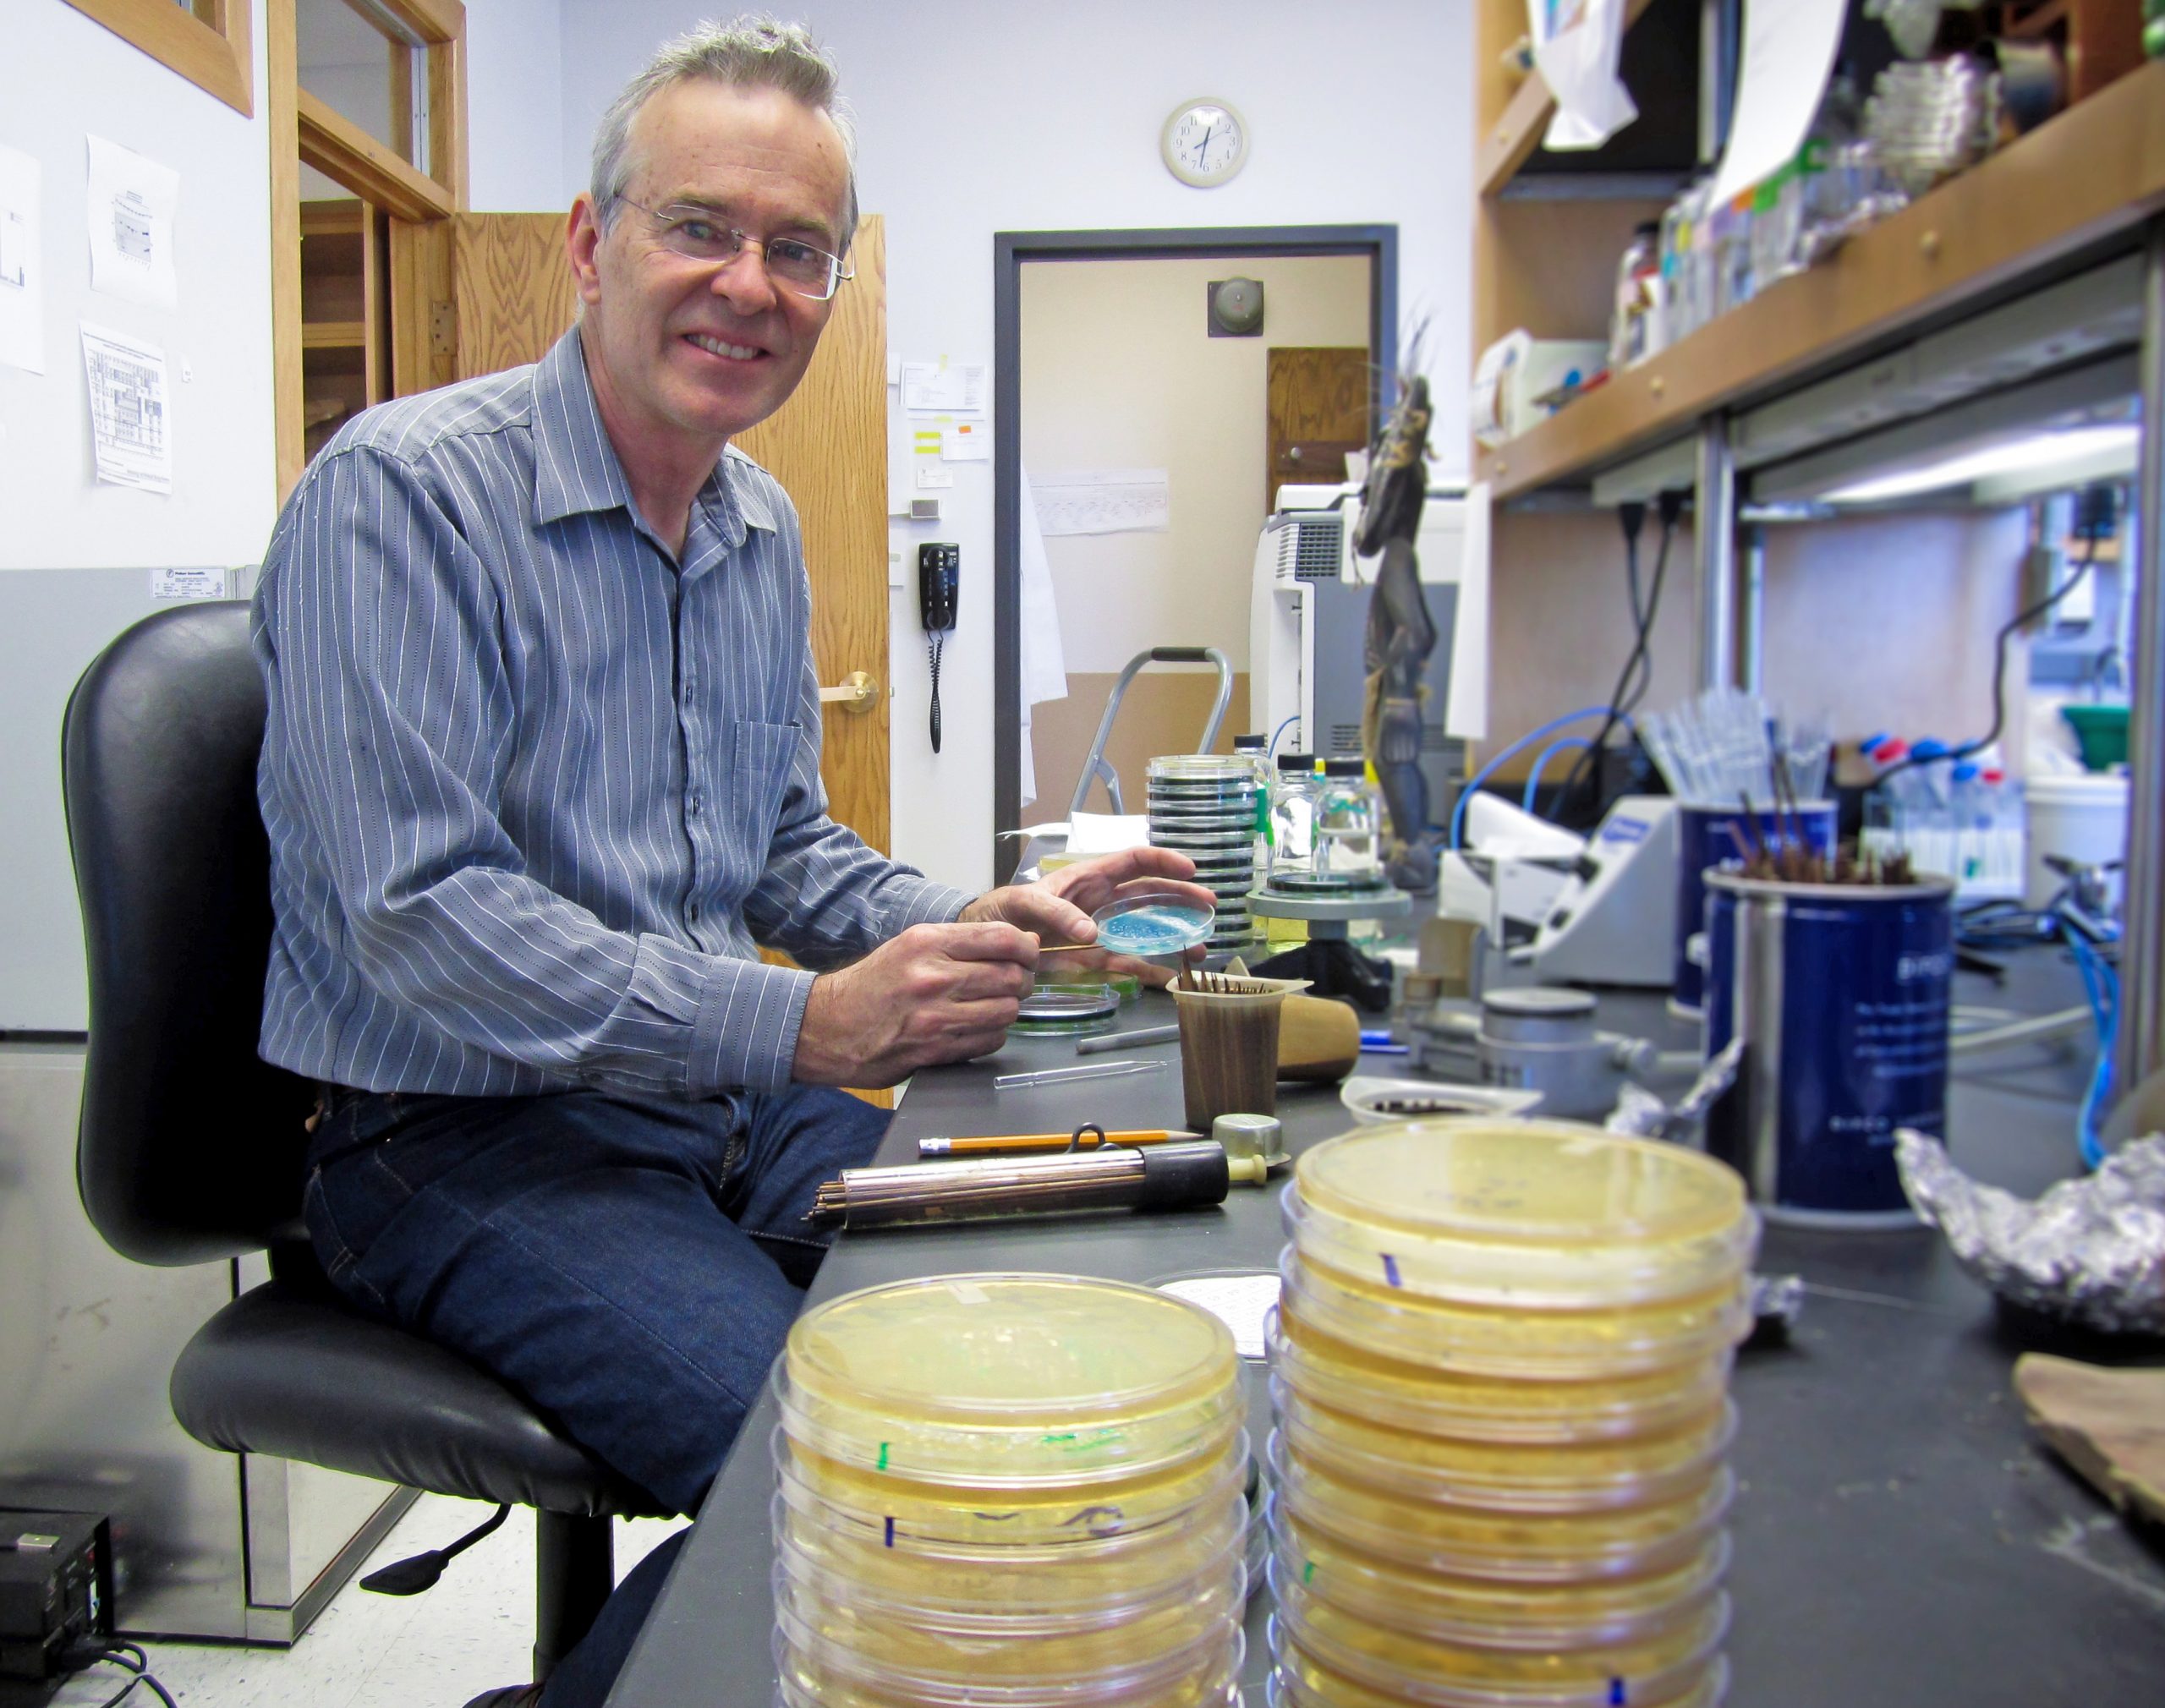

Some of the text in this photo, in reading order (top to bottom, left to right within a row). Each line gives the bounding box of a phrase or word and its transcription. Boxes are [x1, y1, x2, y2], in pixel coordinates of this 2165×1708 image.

[1190, 115, 1198, 126] 11
[1181, 126, 1190, 135] 10
[1225, 123, 1231, 134] 2
[1176, 138, 1182, 148] 9
[1229, 136, 1236, 146] 3
[1181, 151, 1187, 161] 8
[1191, 160, 1197, 169] 7
[1203, 162, 1209, 172] 6
[1215, 159, 1222, 169] 5
